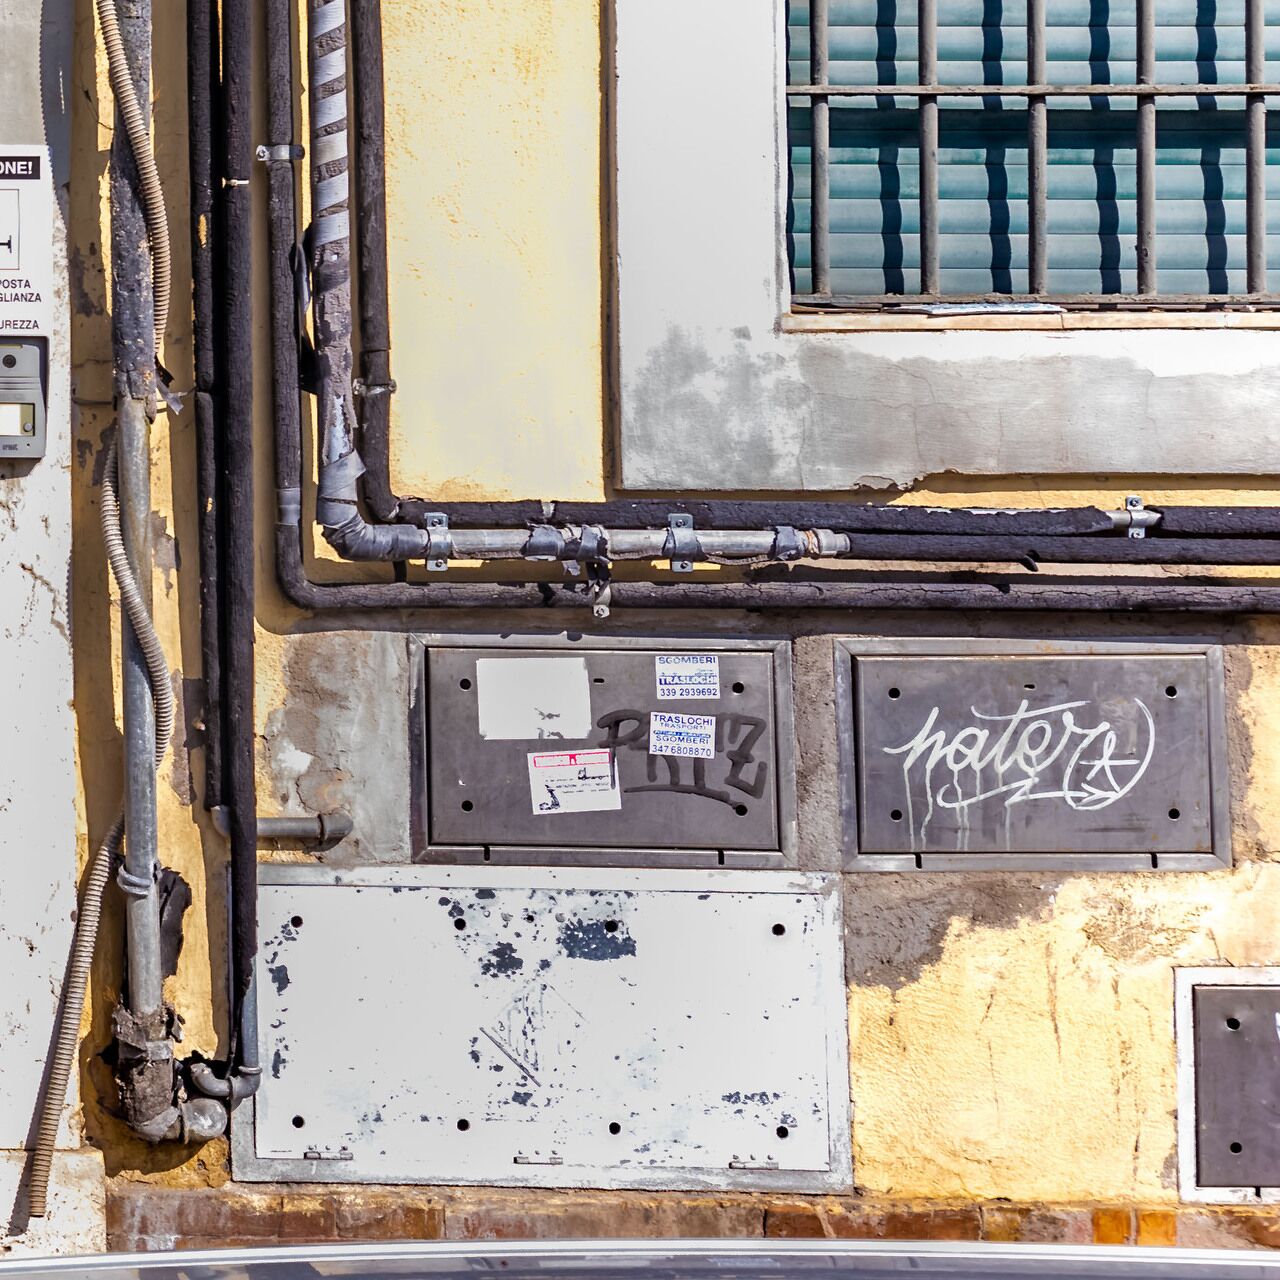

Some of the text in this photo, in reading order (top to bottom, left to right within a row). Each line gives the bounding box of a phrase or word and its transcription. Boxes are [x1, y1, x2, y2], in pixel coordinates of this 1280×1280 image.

[658, 656, 716, 664] SGOMBERI
[660, 688, 717, 696] 339 2939692
[653, 714, 713, 726] TRASLOCHI
[656, 735, 709, 745] SGOMBERI
[652, 745, 669, 753] 347
